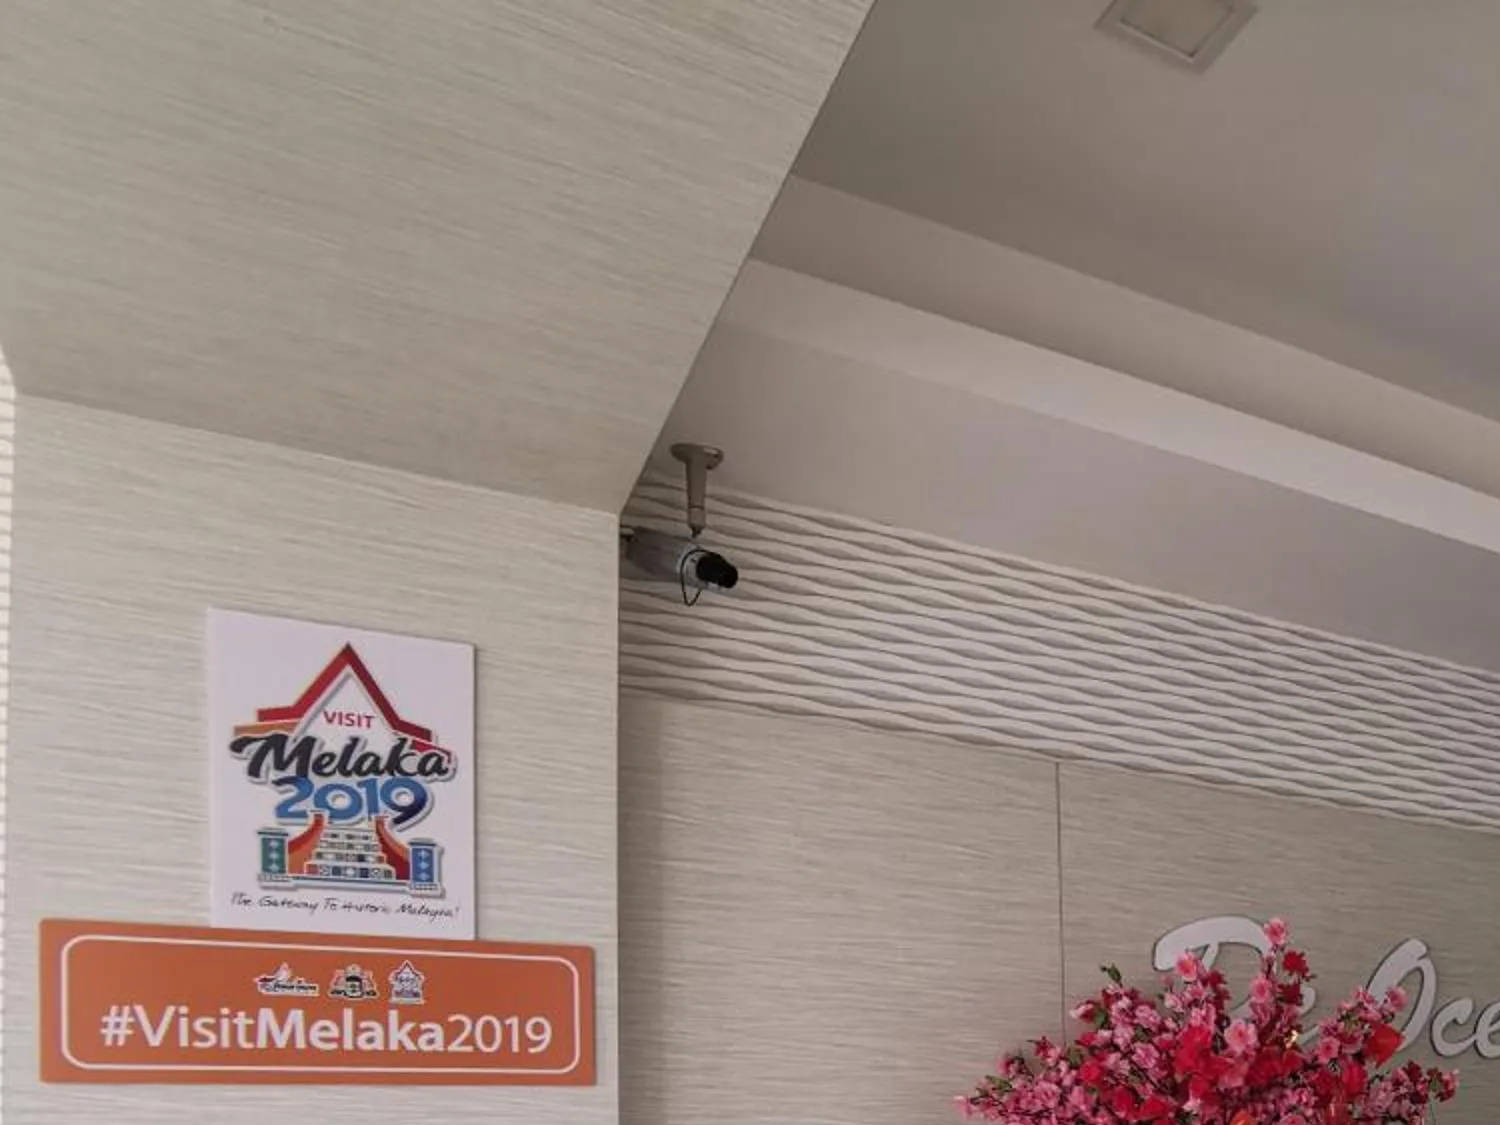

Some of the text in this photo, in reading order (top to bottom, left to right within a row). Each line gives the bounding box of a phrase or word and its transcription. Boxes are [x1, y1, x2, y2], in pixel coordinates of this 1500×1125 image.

[323, 710, 375, 729] VISIT
[229, 734, 450, 779] Melaka
[275, 775, 430, 824] 2019
[257, 896, 319, 917] Gateway
[100, 1004, 553, 1054] #VisitMelaka2019
